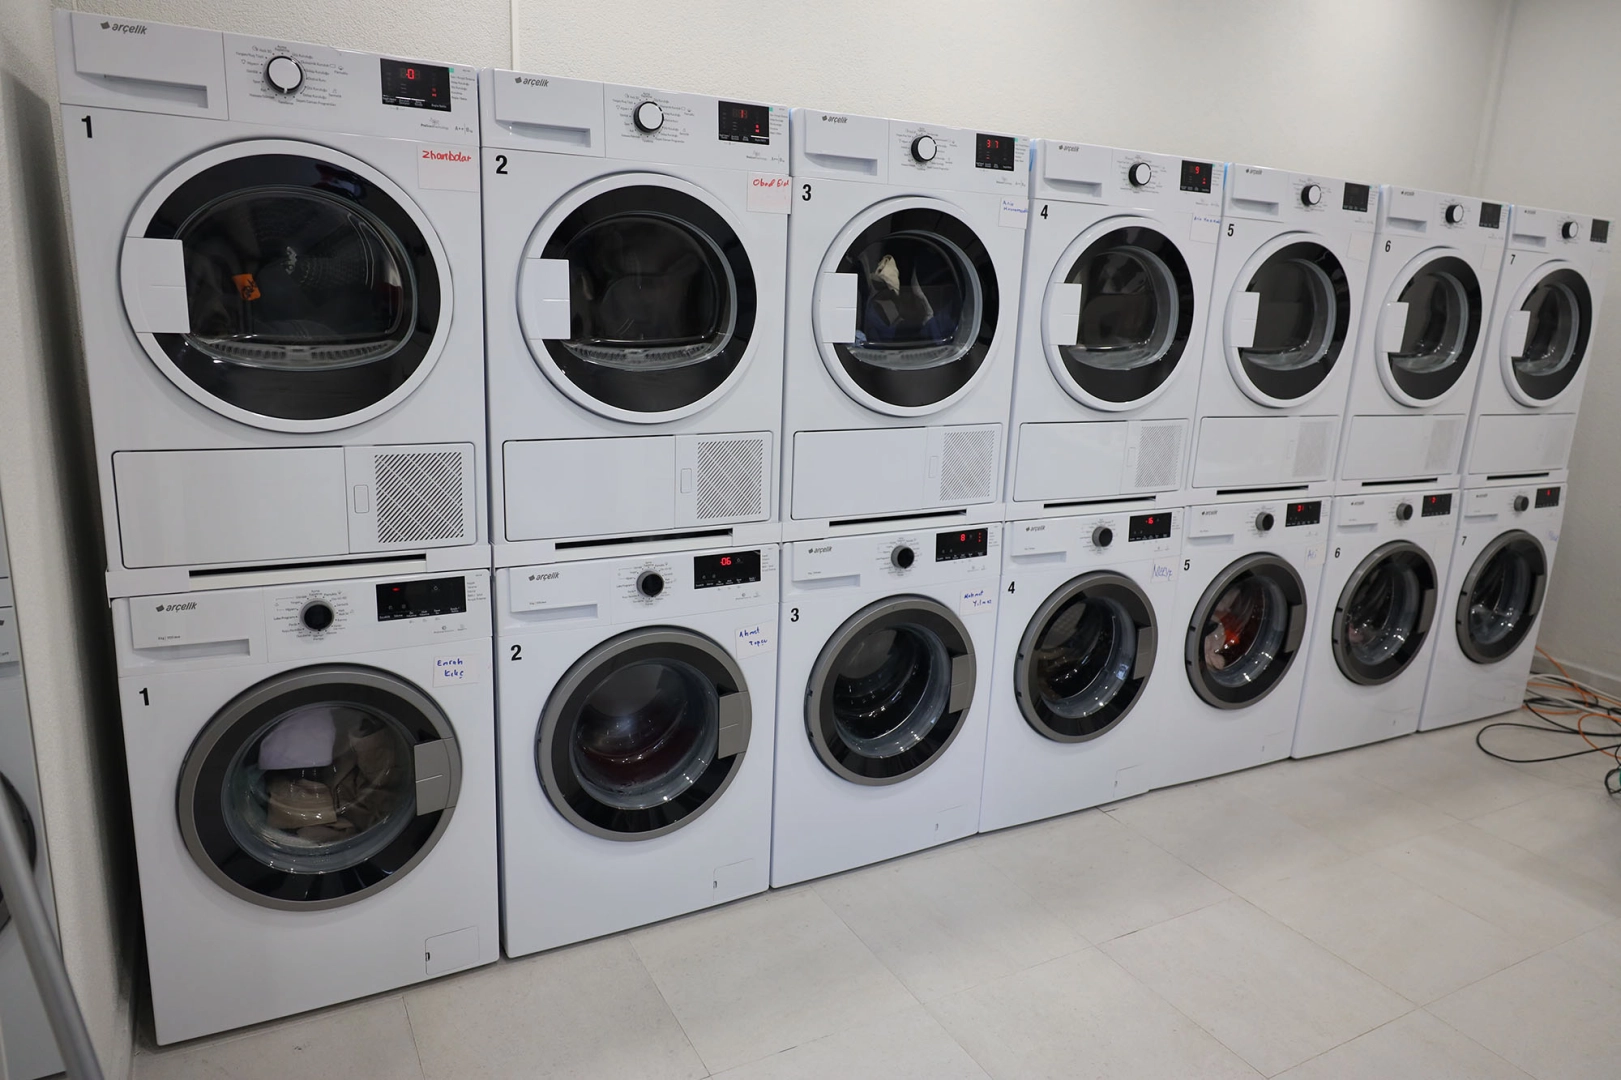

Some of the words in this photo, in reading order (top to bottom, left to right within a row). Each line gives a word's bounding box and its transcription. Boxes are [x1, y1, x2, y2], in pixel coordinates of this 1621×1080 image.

[111, 23, 148, 35] arçelik
[522, 77, 549, 88] arçelik
[827, 116, 848, 124] arçelik
[81, 115, 93, 139] 1
[495, 154, 508, 175] 2
[801, 183, 812, 202] 3
[1040, 204, 1049, 220] 4
[1227, 223, 1235, 237] 5
[1384, 239, 1392, 253] 6
[1509, 253, 1516, 265] 7
[959, 533, 967, 542] 8
[1461, 535, 1468, 546] 7
[813, 546, 833, 554] arçelik
[1334, 547, 1341, 559] 6
[1183, 559, 1191, 571] 5
[533, 571, 560, 581] arçelik
[1007, 580, 1016, 594] 4
[165, 601, 198, 613] arçelik
[790, 607, 800, 623] 3
[510, 644, 523, 662] 2
[138, 687, 150, 706] 1
